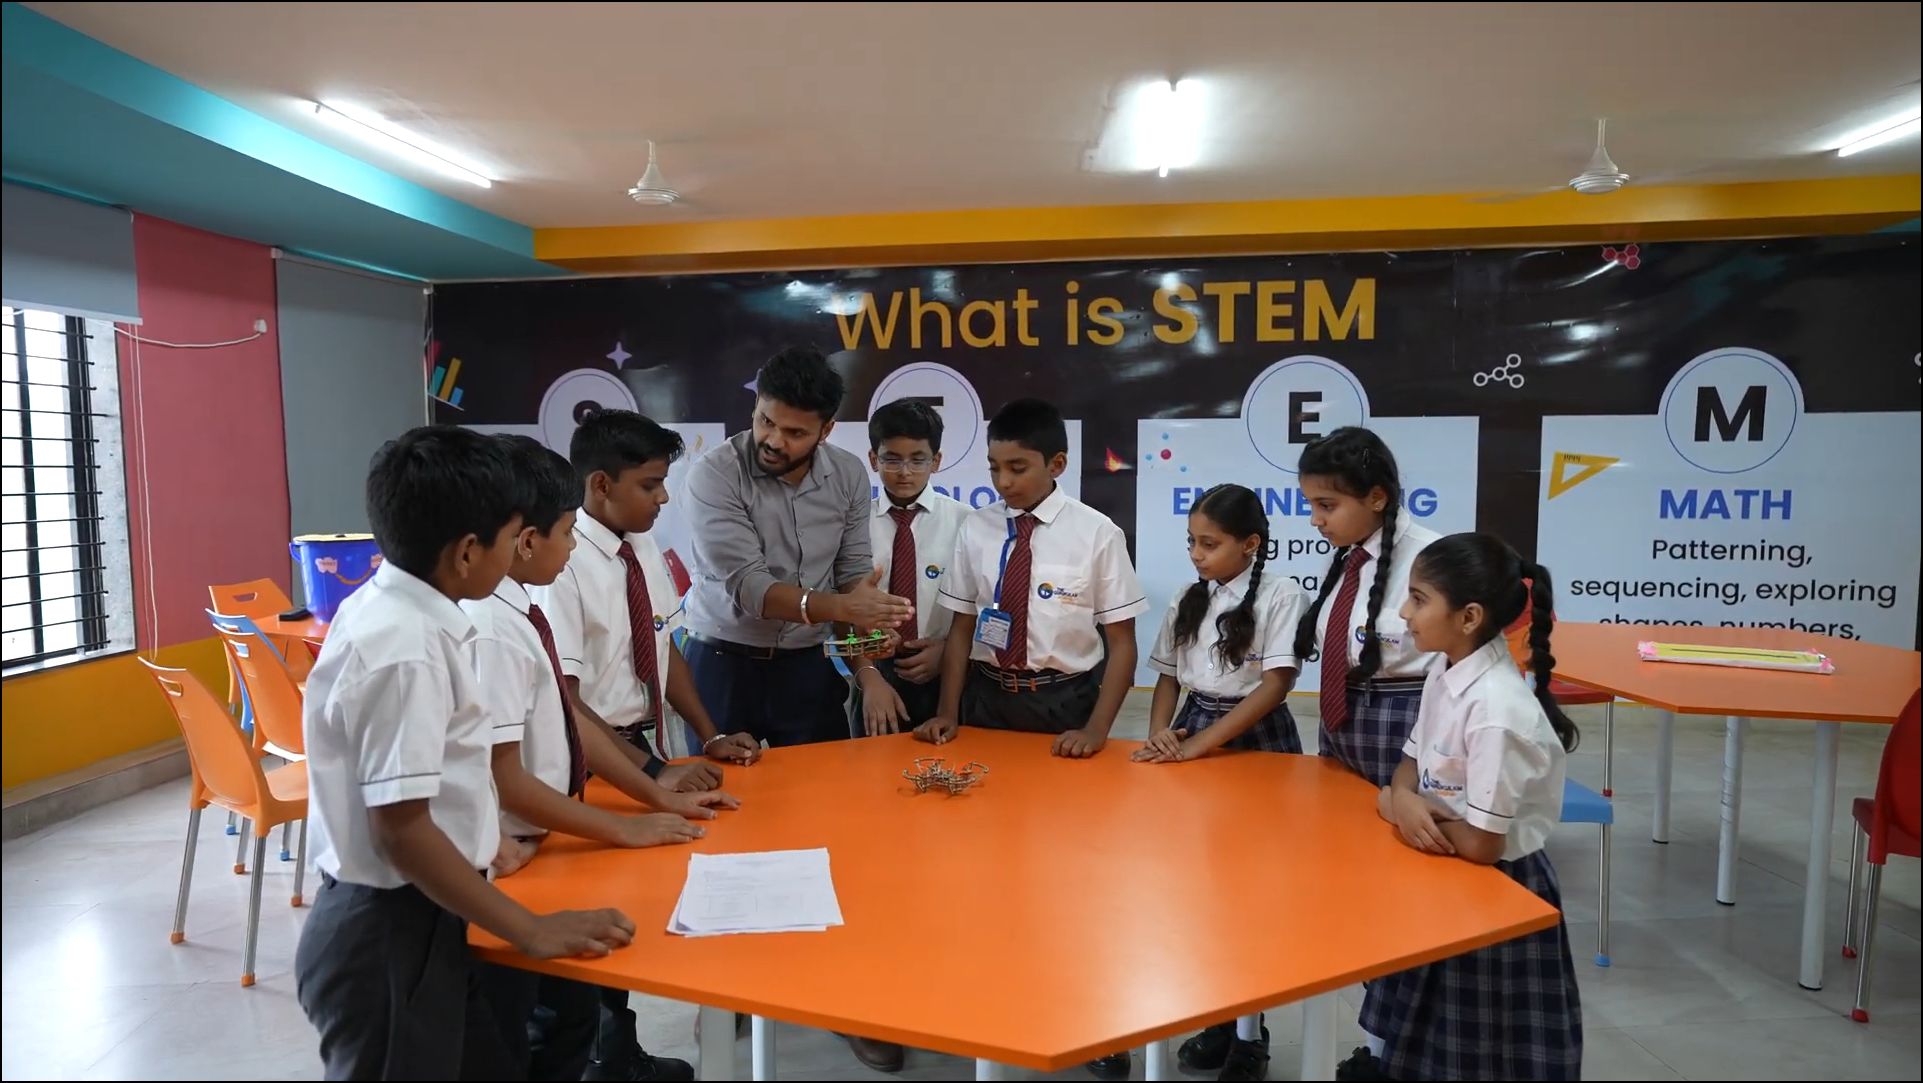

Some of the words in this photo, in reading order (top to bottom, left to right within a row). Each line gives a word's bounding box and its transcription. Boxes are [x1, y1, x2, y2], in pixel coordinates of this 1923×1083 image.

[832, 287, 1040, 350] What
[1066, 280, 1125, 346] is
[1153, 278, 1376, 344] STEM
[1288, 391, 1323, 444] E
[1694, 385, 1768, 442] M
[1659, 489, 1792, 520] MATH
[1652, 539, 1813, 568] Patterning,
[1571, 577, 1747, 606] sequencing,
[1755, 579, 1897, 609] exploring
